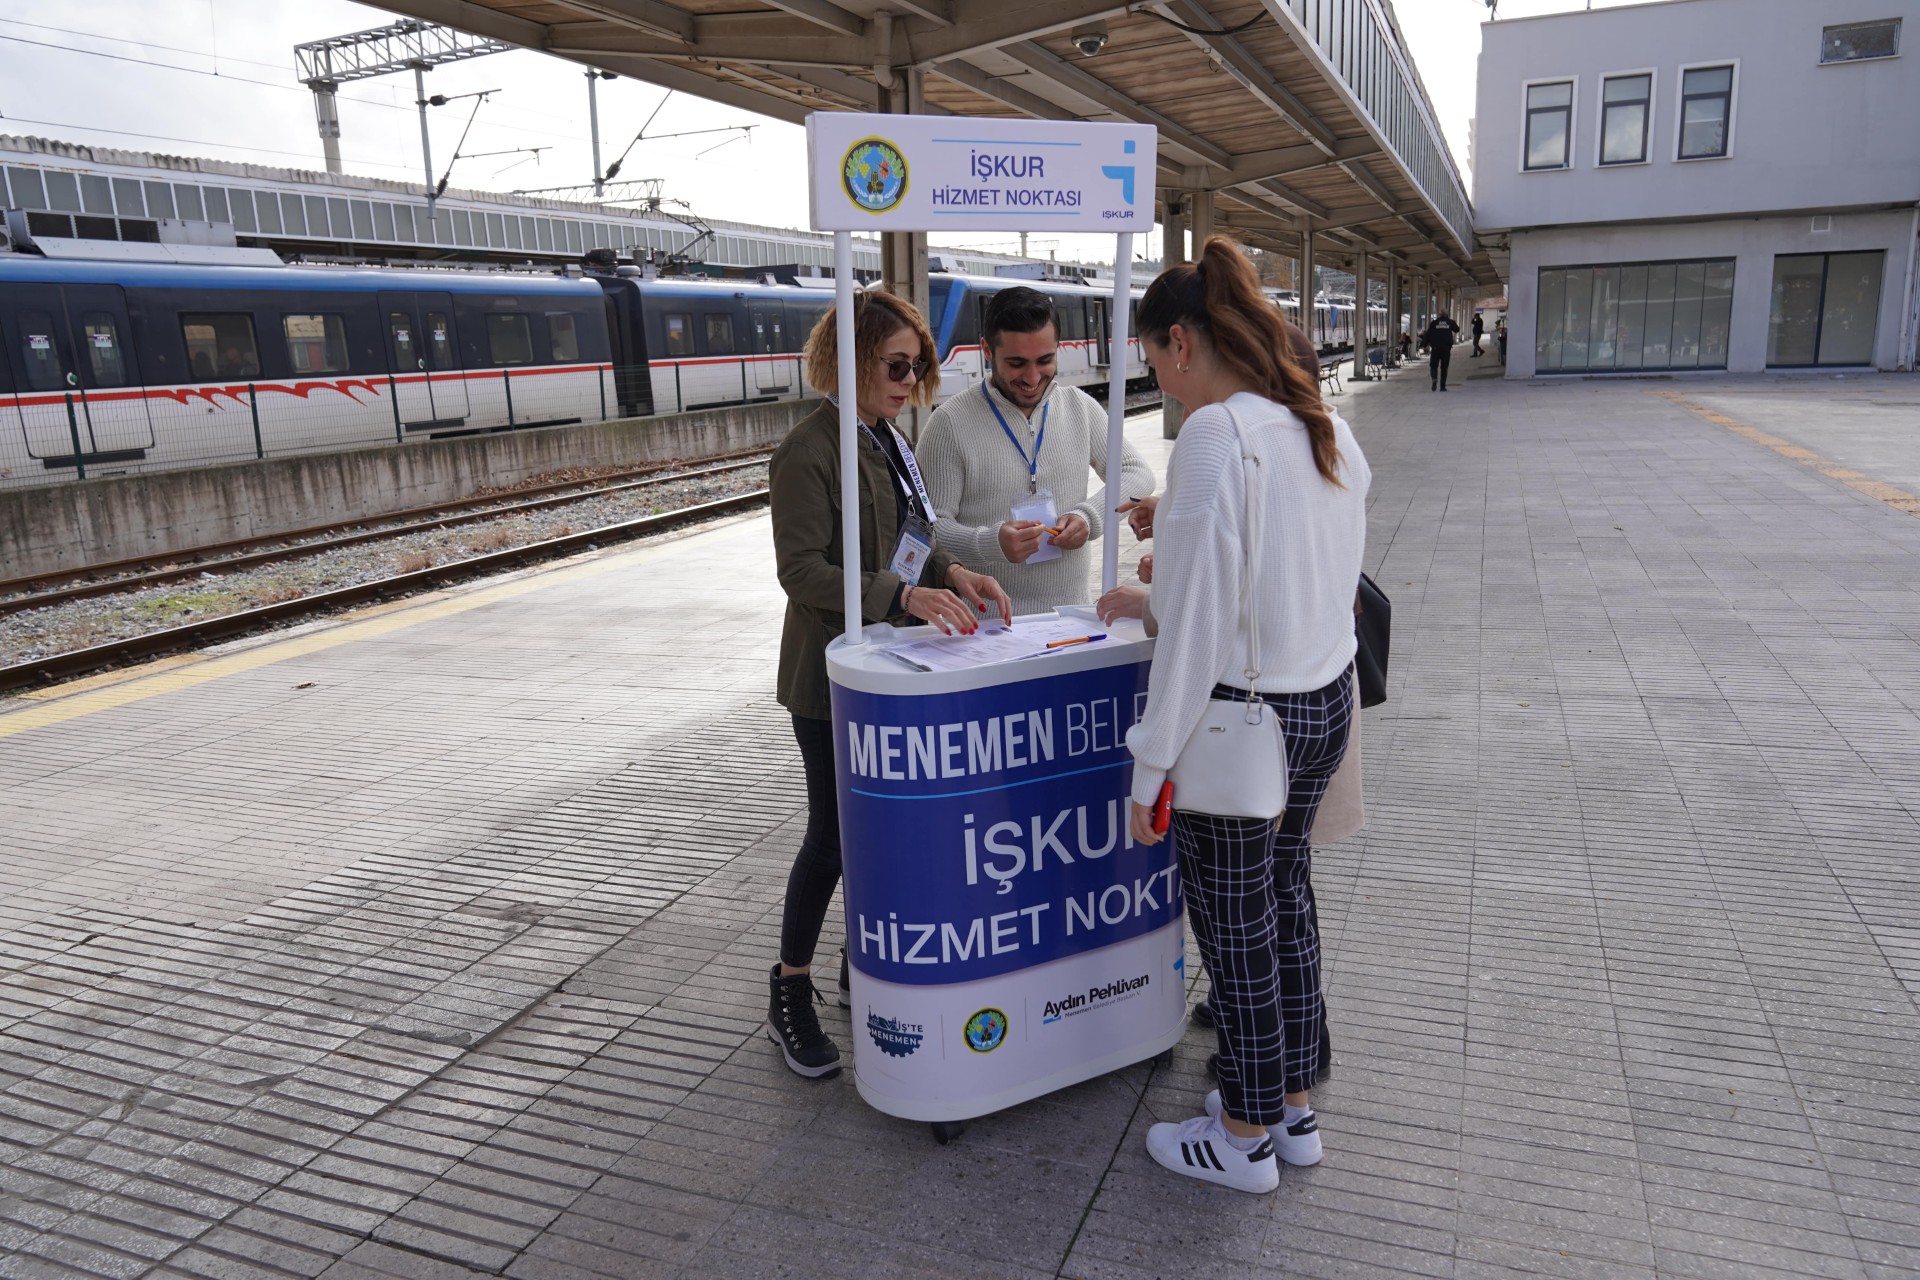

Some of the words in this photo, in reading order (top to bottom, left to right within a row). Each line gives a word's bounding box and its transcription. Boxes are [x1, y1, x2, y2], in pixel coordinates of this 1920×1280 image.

[971, 149, 1044, 183] İŞKUR
[932, 185, 1001, 206] HİZMET
[1006, 189, 1081, 206] NOKTASI
[908, 463, 924, 493] MENEMEN
[848, 708, 1055, 780] MENEMEN
[1066, 692, 1150, 757] BELE
[858, 902, 1050, 964] HİZMET
[1065, 863, 1182, 937] NOKT
[1043, 994, 1086, 1018] Aydın
[1089, 974, 1149, 1003] Pehlivan
[1064, 1006, 1092, 1018] Menemen
[871, 1027, 917, 1046] MENEMEN
